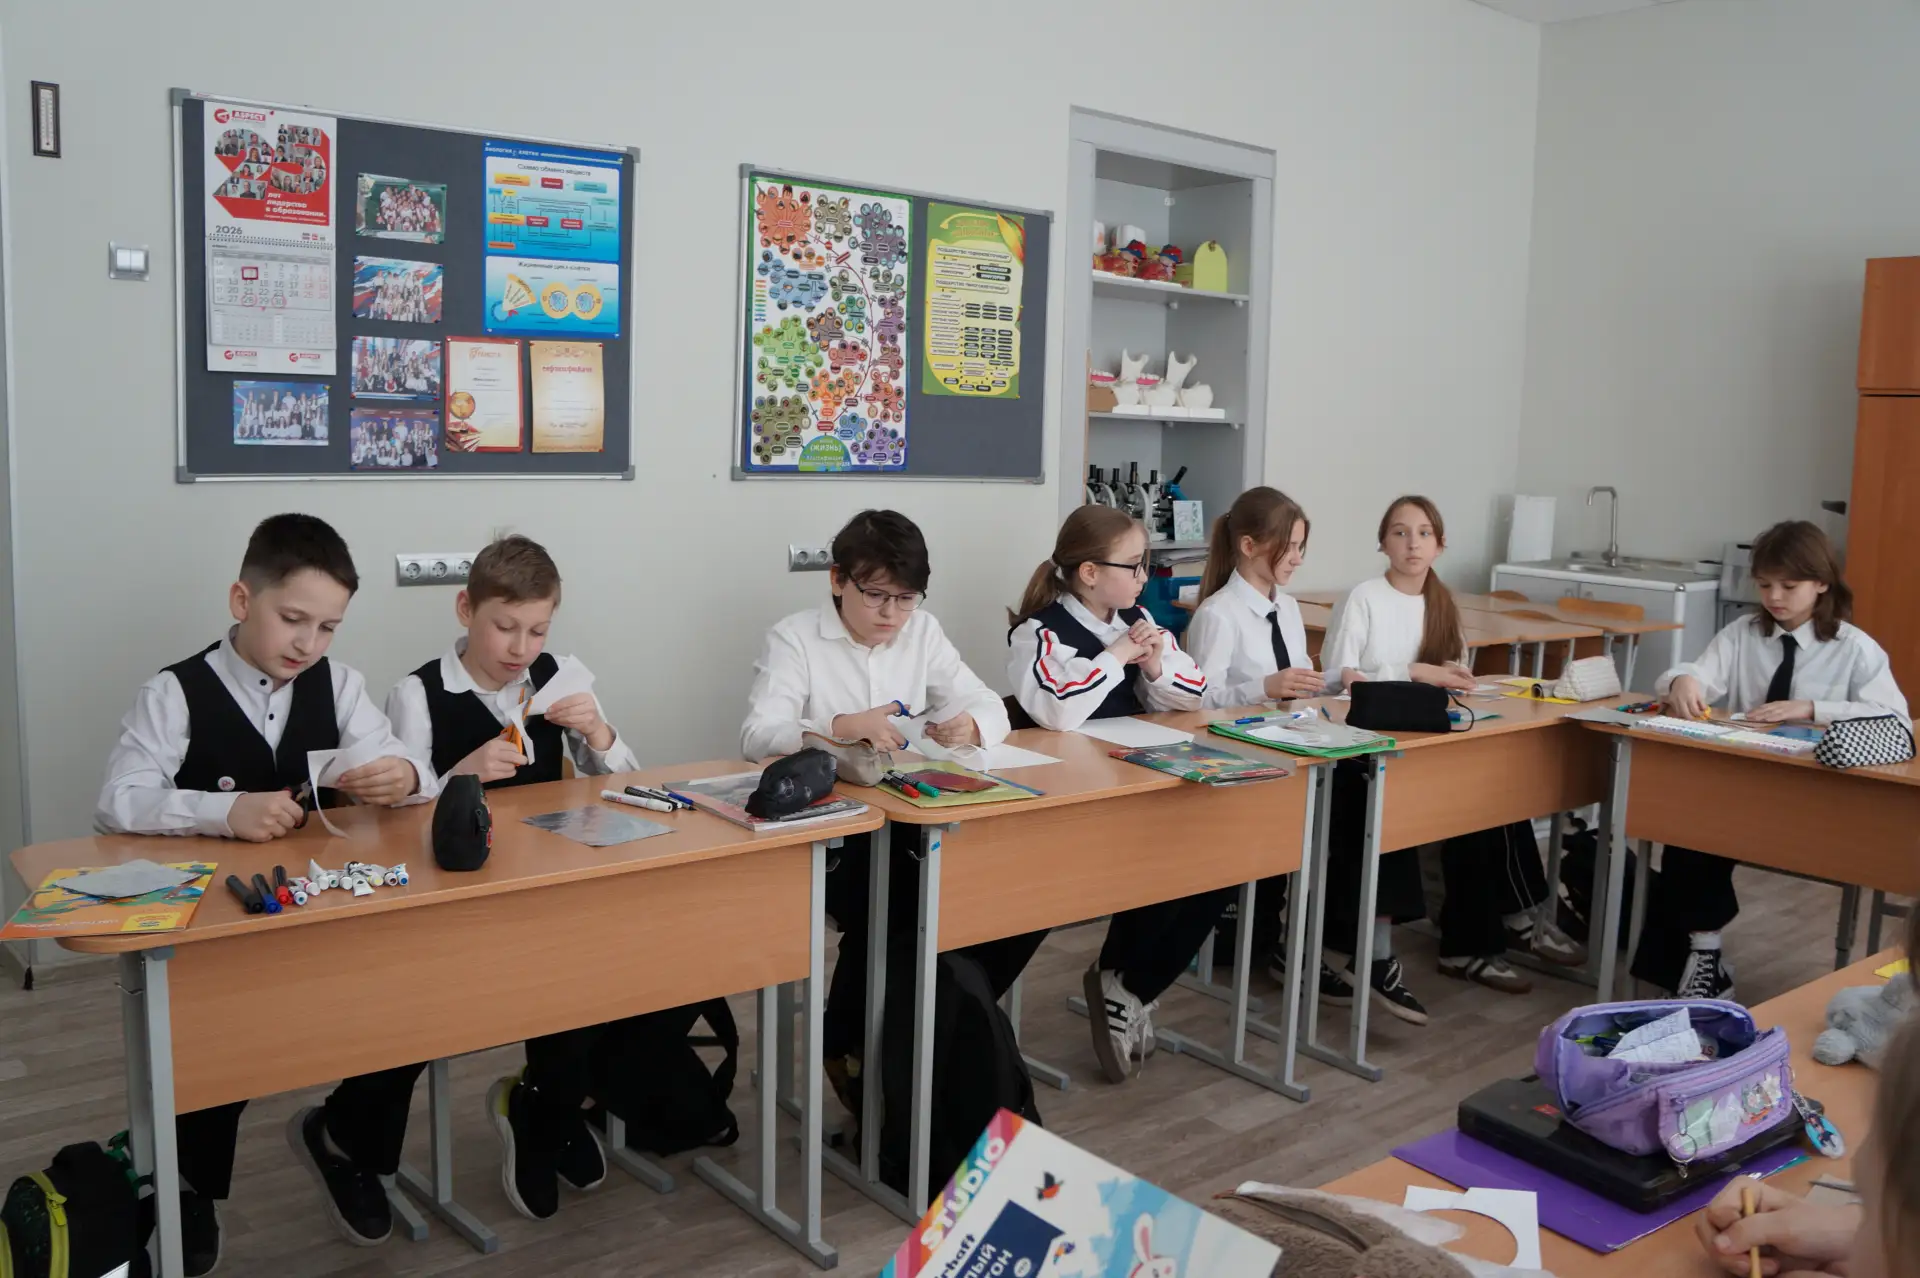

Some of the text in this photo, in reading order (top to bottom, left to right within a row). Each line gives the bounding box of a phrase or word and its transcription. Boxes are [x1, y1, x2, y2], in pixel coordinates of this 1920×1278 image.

[215, 225, 243, 235] 2026
[920, 1136, 1006, 1251] STUDIO
[935, 1233, 975, 1278] rhaft
